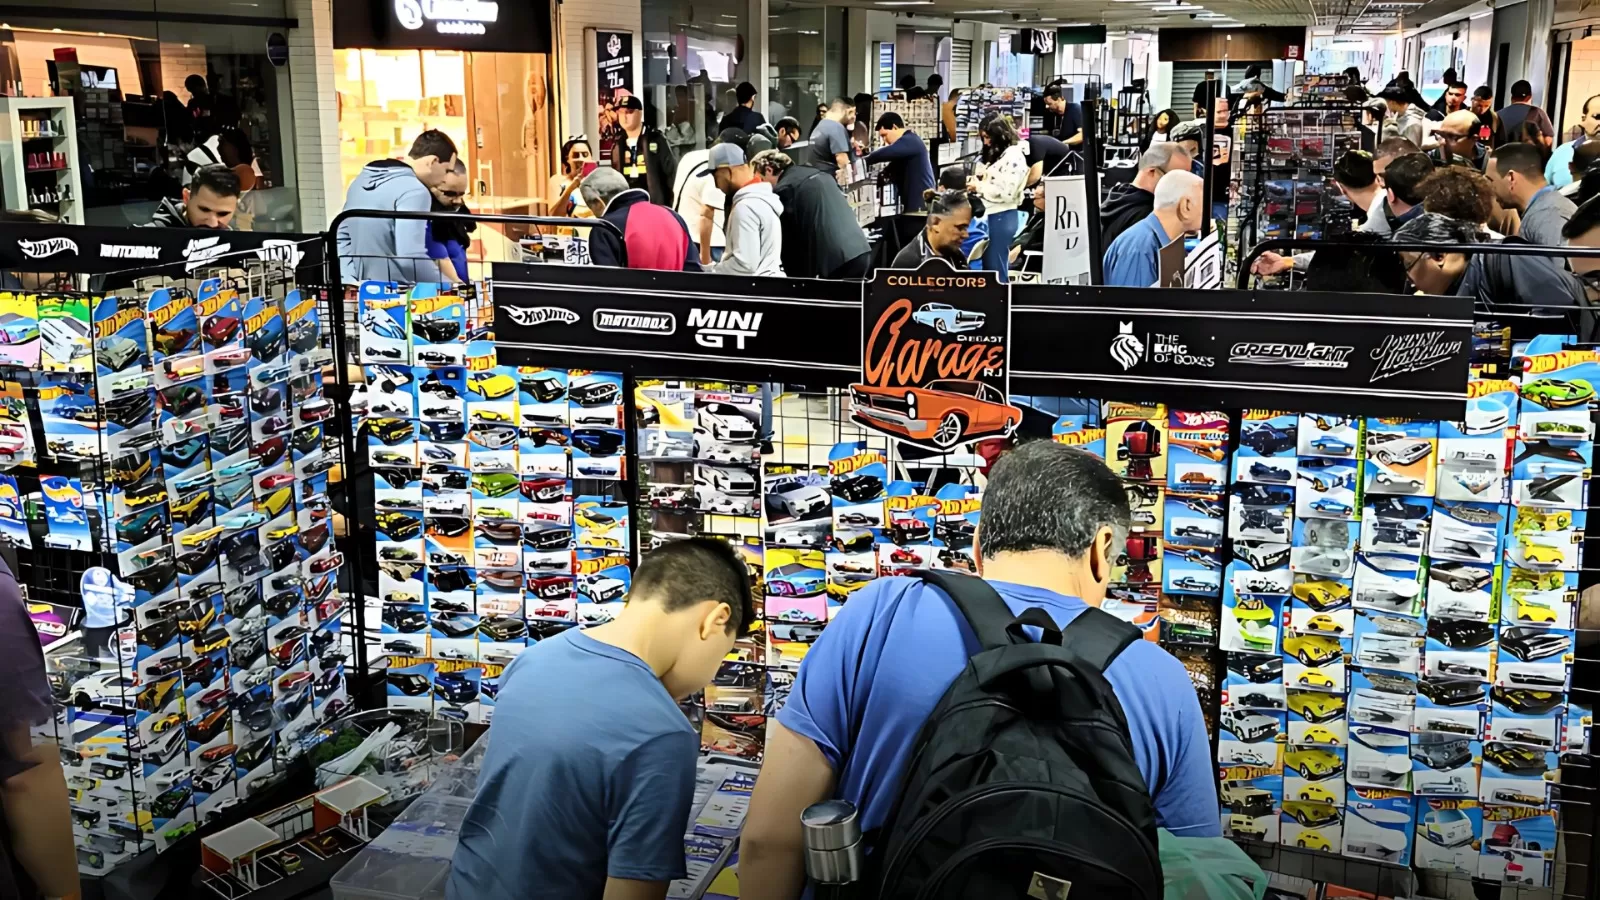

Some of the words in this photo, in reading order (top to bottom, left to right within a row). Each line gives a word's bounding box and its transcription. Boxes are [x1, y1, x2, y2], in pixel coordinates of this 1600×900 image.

[887, 275, 986, 287] COLLECTORS
[686, 308, 763, 331] MINI
[694, 328, 758, 349] GT
[865, 298, 1004, 389] Garage
[1155, 333, 1179, 345] THE
[1230, 342, 1354, 361] GREENLIGHT
[983, 368, 1003, 378] RJ
